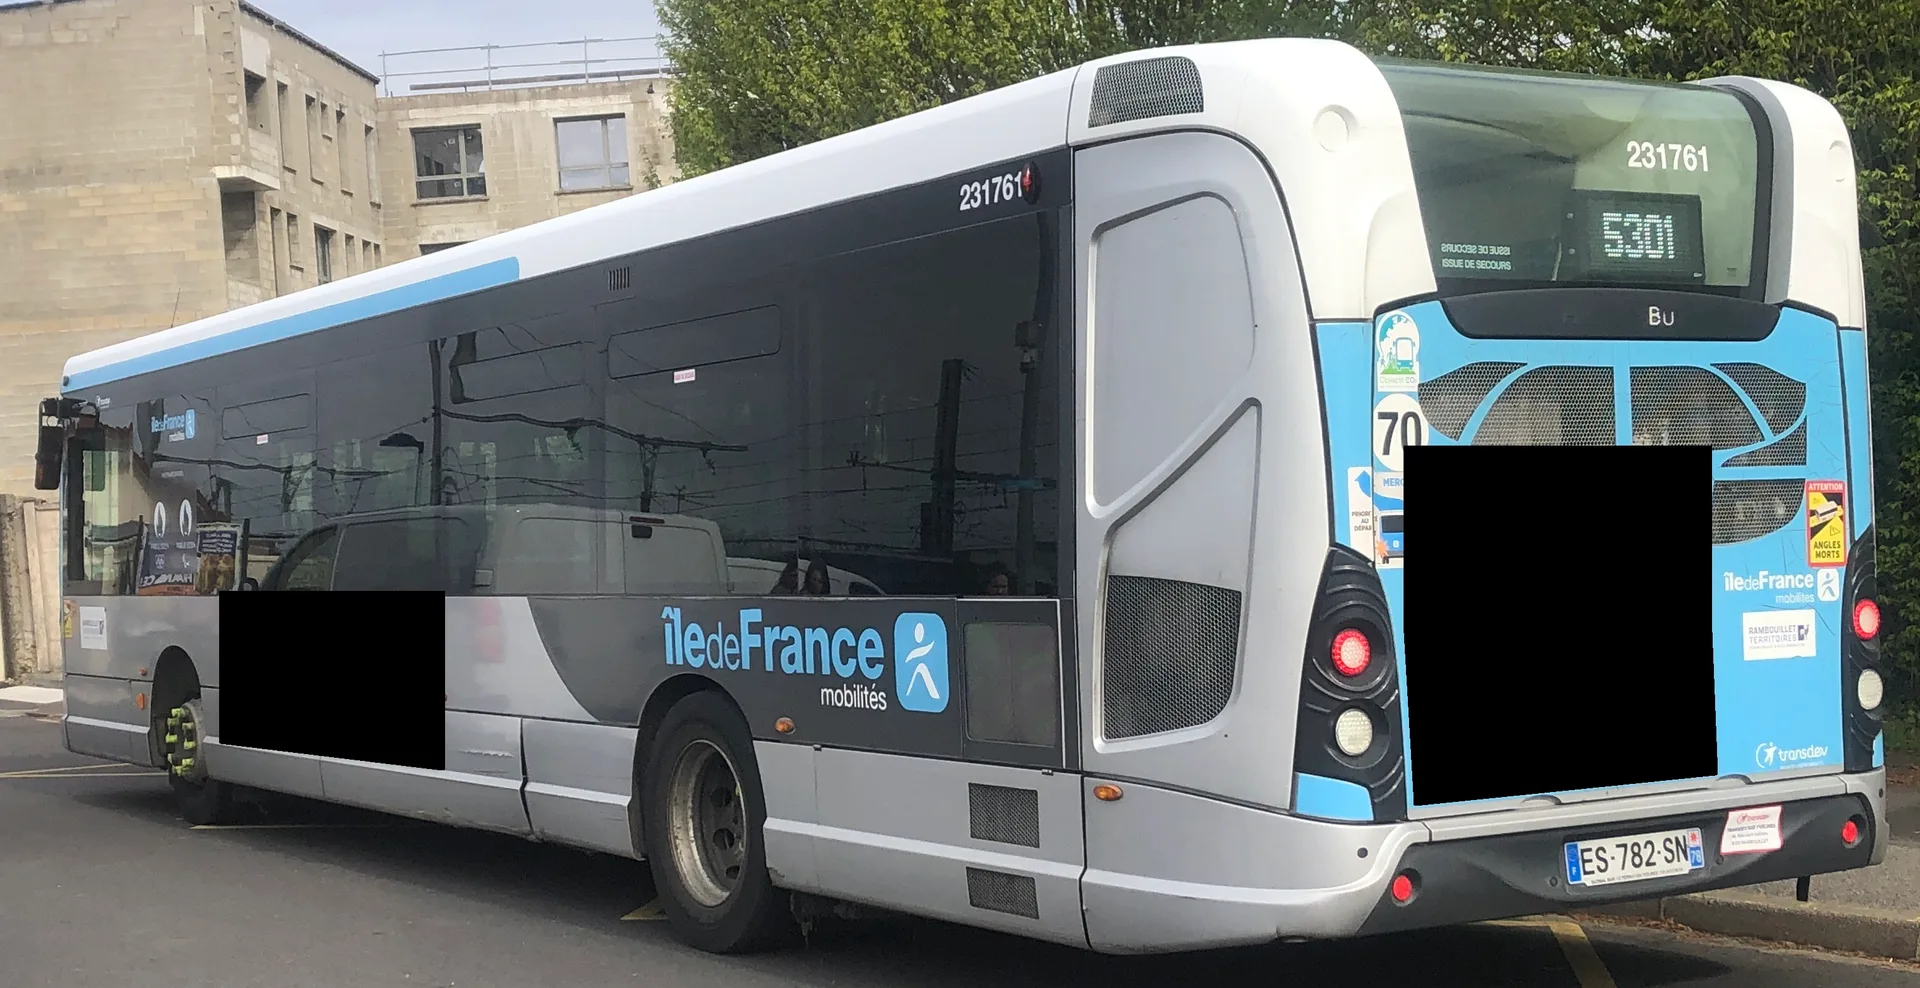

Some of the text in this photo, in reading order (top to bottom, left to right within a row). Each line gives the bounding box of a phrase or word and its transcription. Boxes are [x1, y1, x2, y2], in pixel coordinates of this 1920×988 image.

[1627, 140, 1708, 172] 231761
[959, 171, 1023, 211] 231761
[1602, 212, 1675, 259] 5301
[1441, 258, 1512, 271] ISSUE DE SECOURS
[1377, 411, 1423, 456] 70
[1808, 482, 1843, 491] ATTENTION
[1813, 540, 1841, 550] ANGLES
[1815, 550, 1840, 559] MORTS
[1723, 570, 1814, 592] îledeFrance
[1748, 624, 1797, 635] RAMBOUILLET
[1749, 634, 1797, 645] TERRITOIRES
[661, 605, 885, 680] îledeFrance
[820, 684, 887, 711] mobilités
[1778, 745, 1828, 761] transdev
[1580, 835, 1689, 876] ES-782-SN
